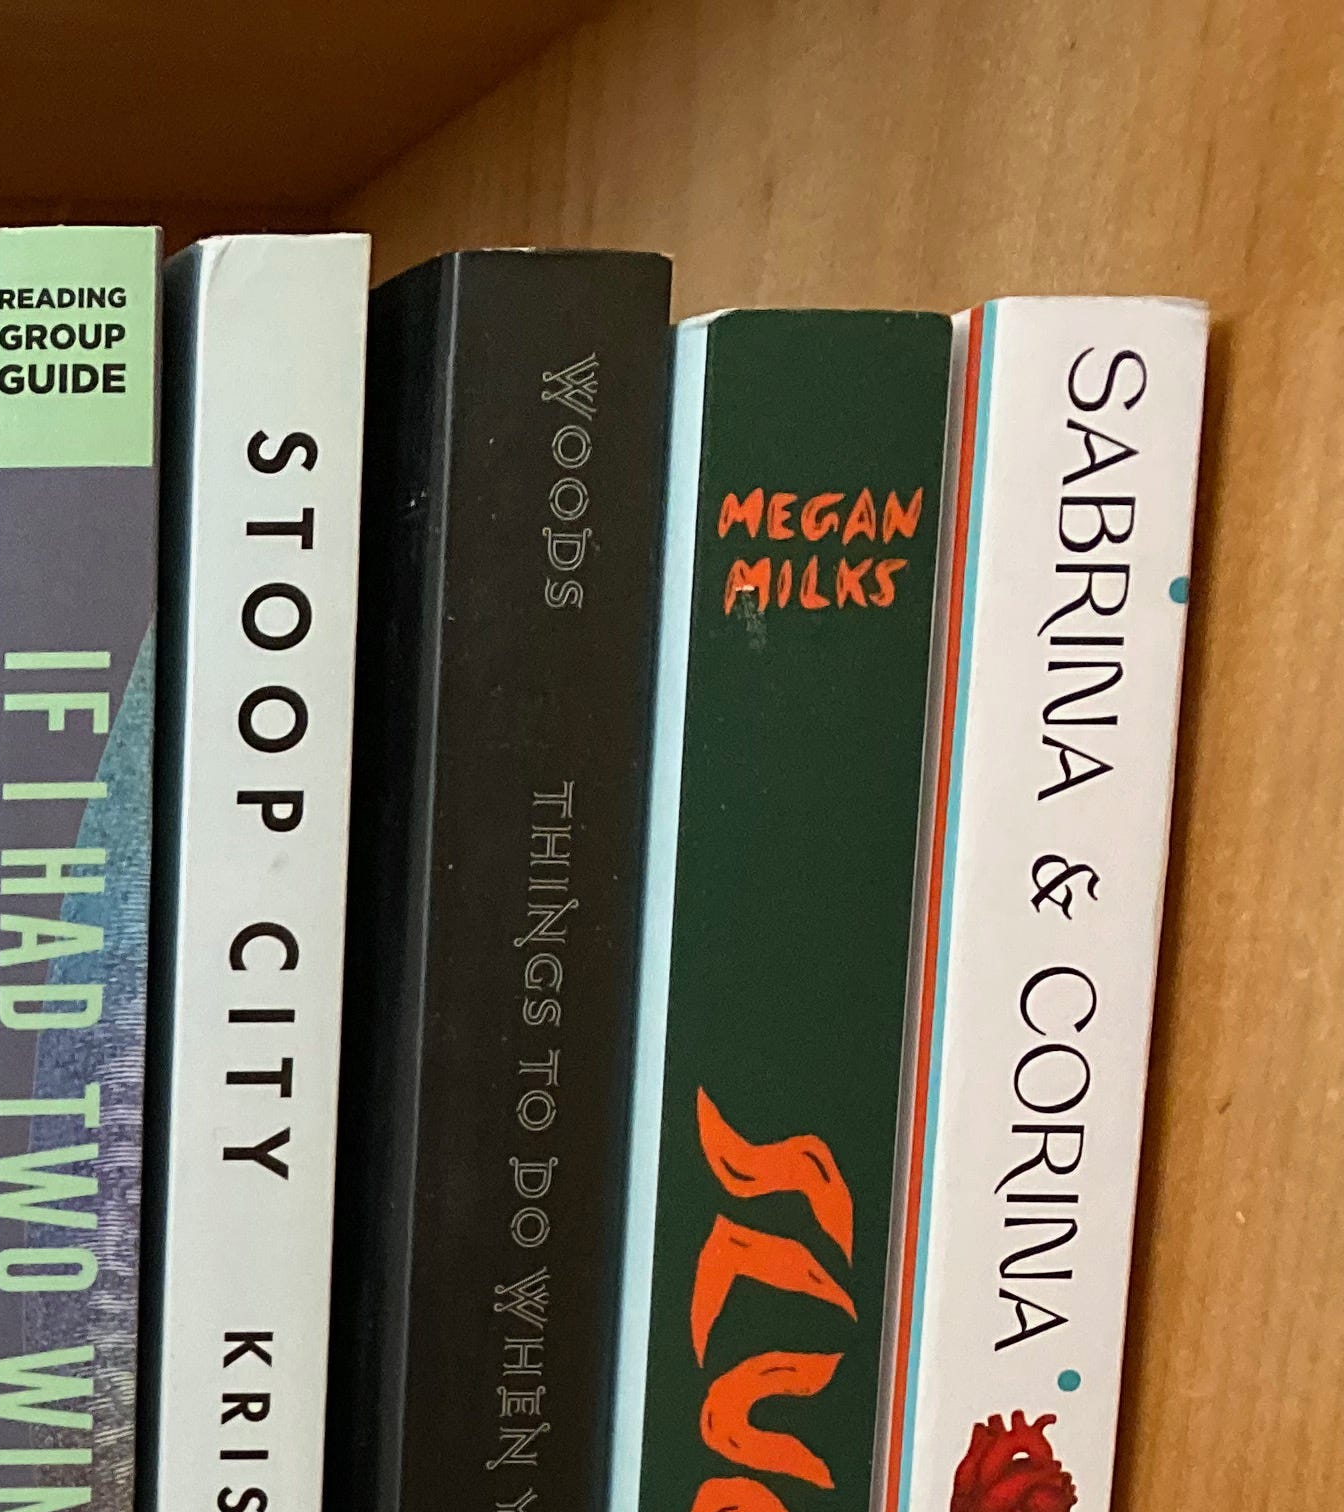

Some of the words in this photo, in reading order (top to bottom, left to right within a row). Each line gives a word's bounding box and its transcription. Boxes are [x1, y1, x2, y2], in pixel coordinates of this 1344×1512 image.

[541, 352, 600, 610] WOODS
[717, 487, 924, 546] MEGAN
[236, 430, 319, 834] STOOP
[723, 555, 909, 615] MILKS
[1037, 348, 1148, 802] SABRINA
[4, 651, 111, 735] IF
[2, 782, 108, 801] I
[514, 780, 579, 1027] THINGS
[1031, 853, 1101, 921] &
[222, 921, 300, 1180] CITY
[516, 1048, 561, 1132] TO
[509, 1156, 558, 1248] DO
[994, 966, 1098, 1352] CORINA
[485, 1265, 551, 1471] WHEN
